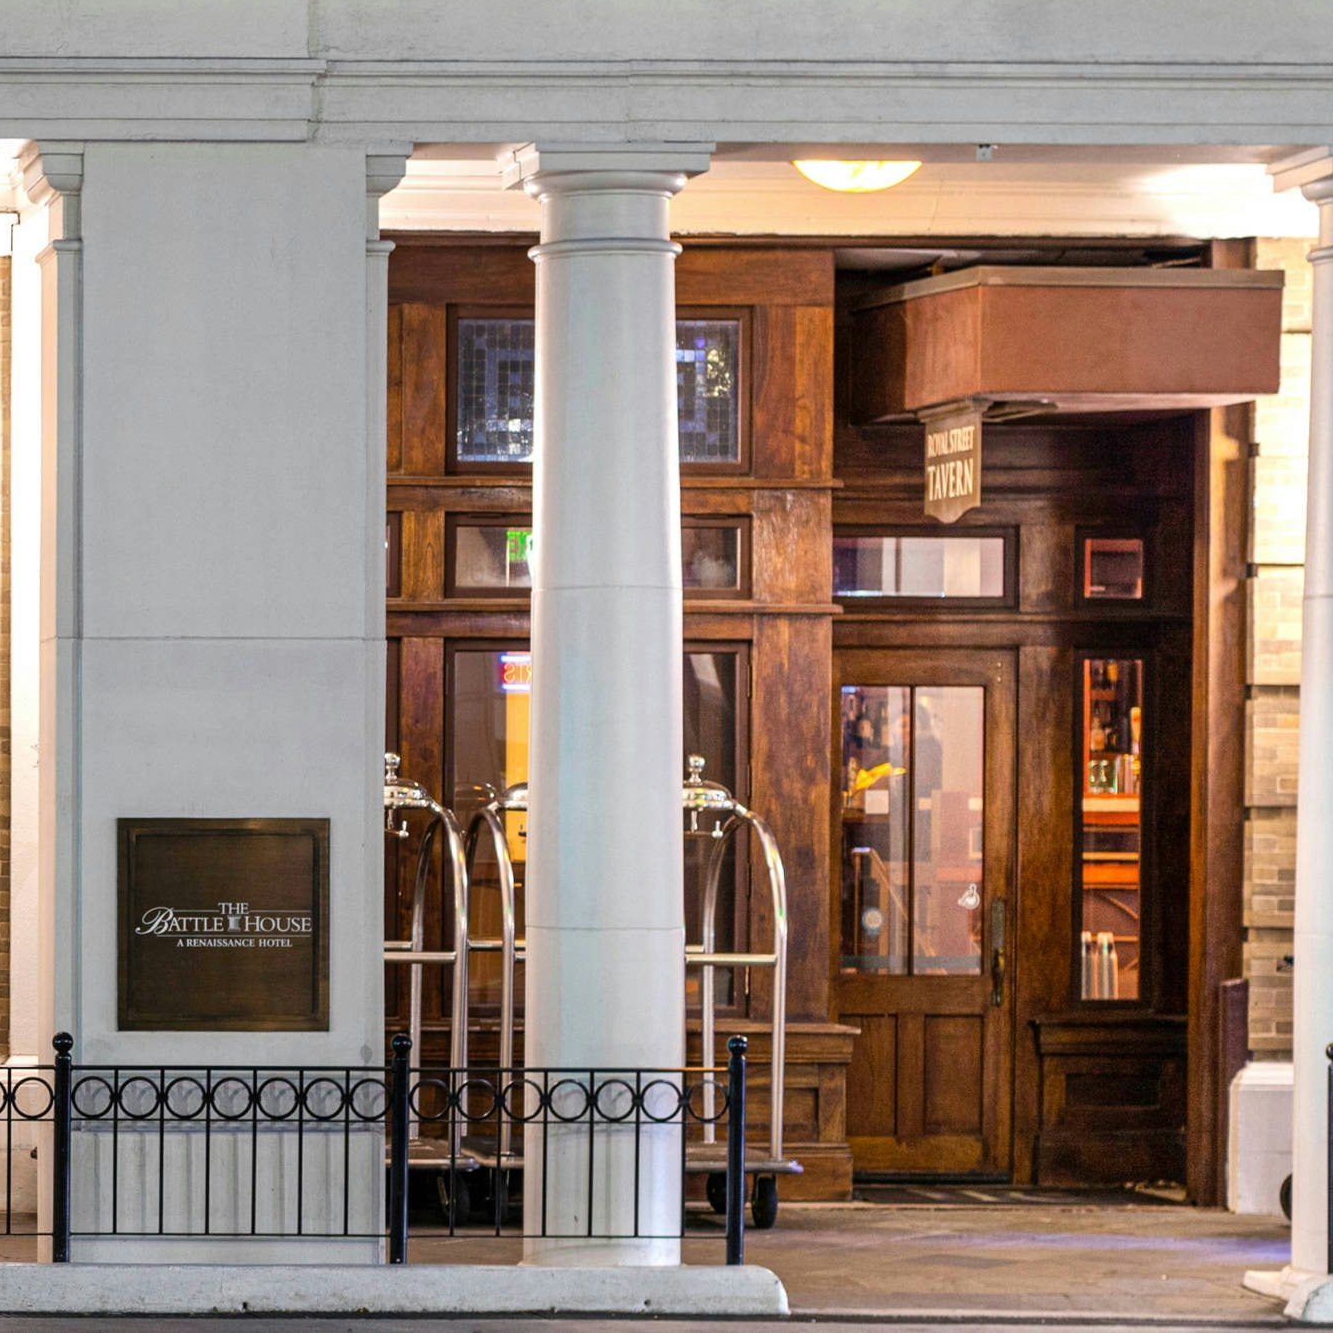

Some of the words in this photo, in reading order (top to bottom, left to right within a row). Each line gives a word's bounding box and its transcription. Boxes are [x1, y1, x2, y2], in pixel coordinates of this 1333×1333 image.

[928, 430, 949, 457] ROYAL
[950, 426, 975, 454] STREET
[927, 458, 973, 501] TAVERN
[135, 907, 223, 935] BATTLE
[245, 917, 312, 932] HOUSE
[218, 903, 249, 914] THE
[177, 939, 184, 947] A
[186, 939, 255, 947] RENAISSANCE
[259, 939, 292, 947] HOTEL
